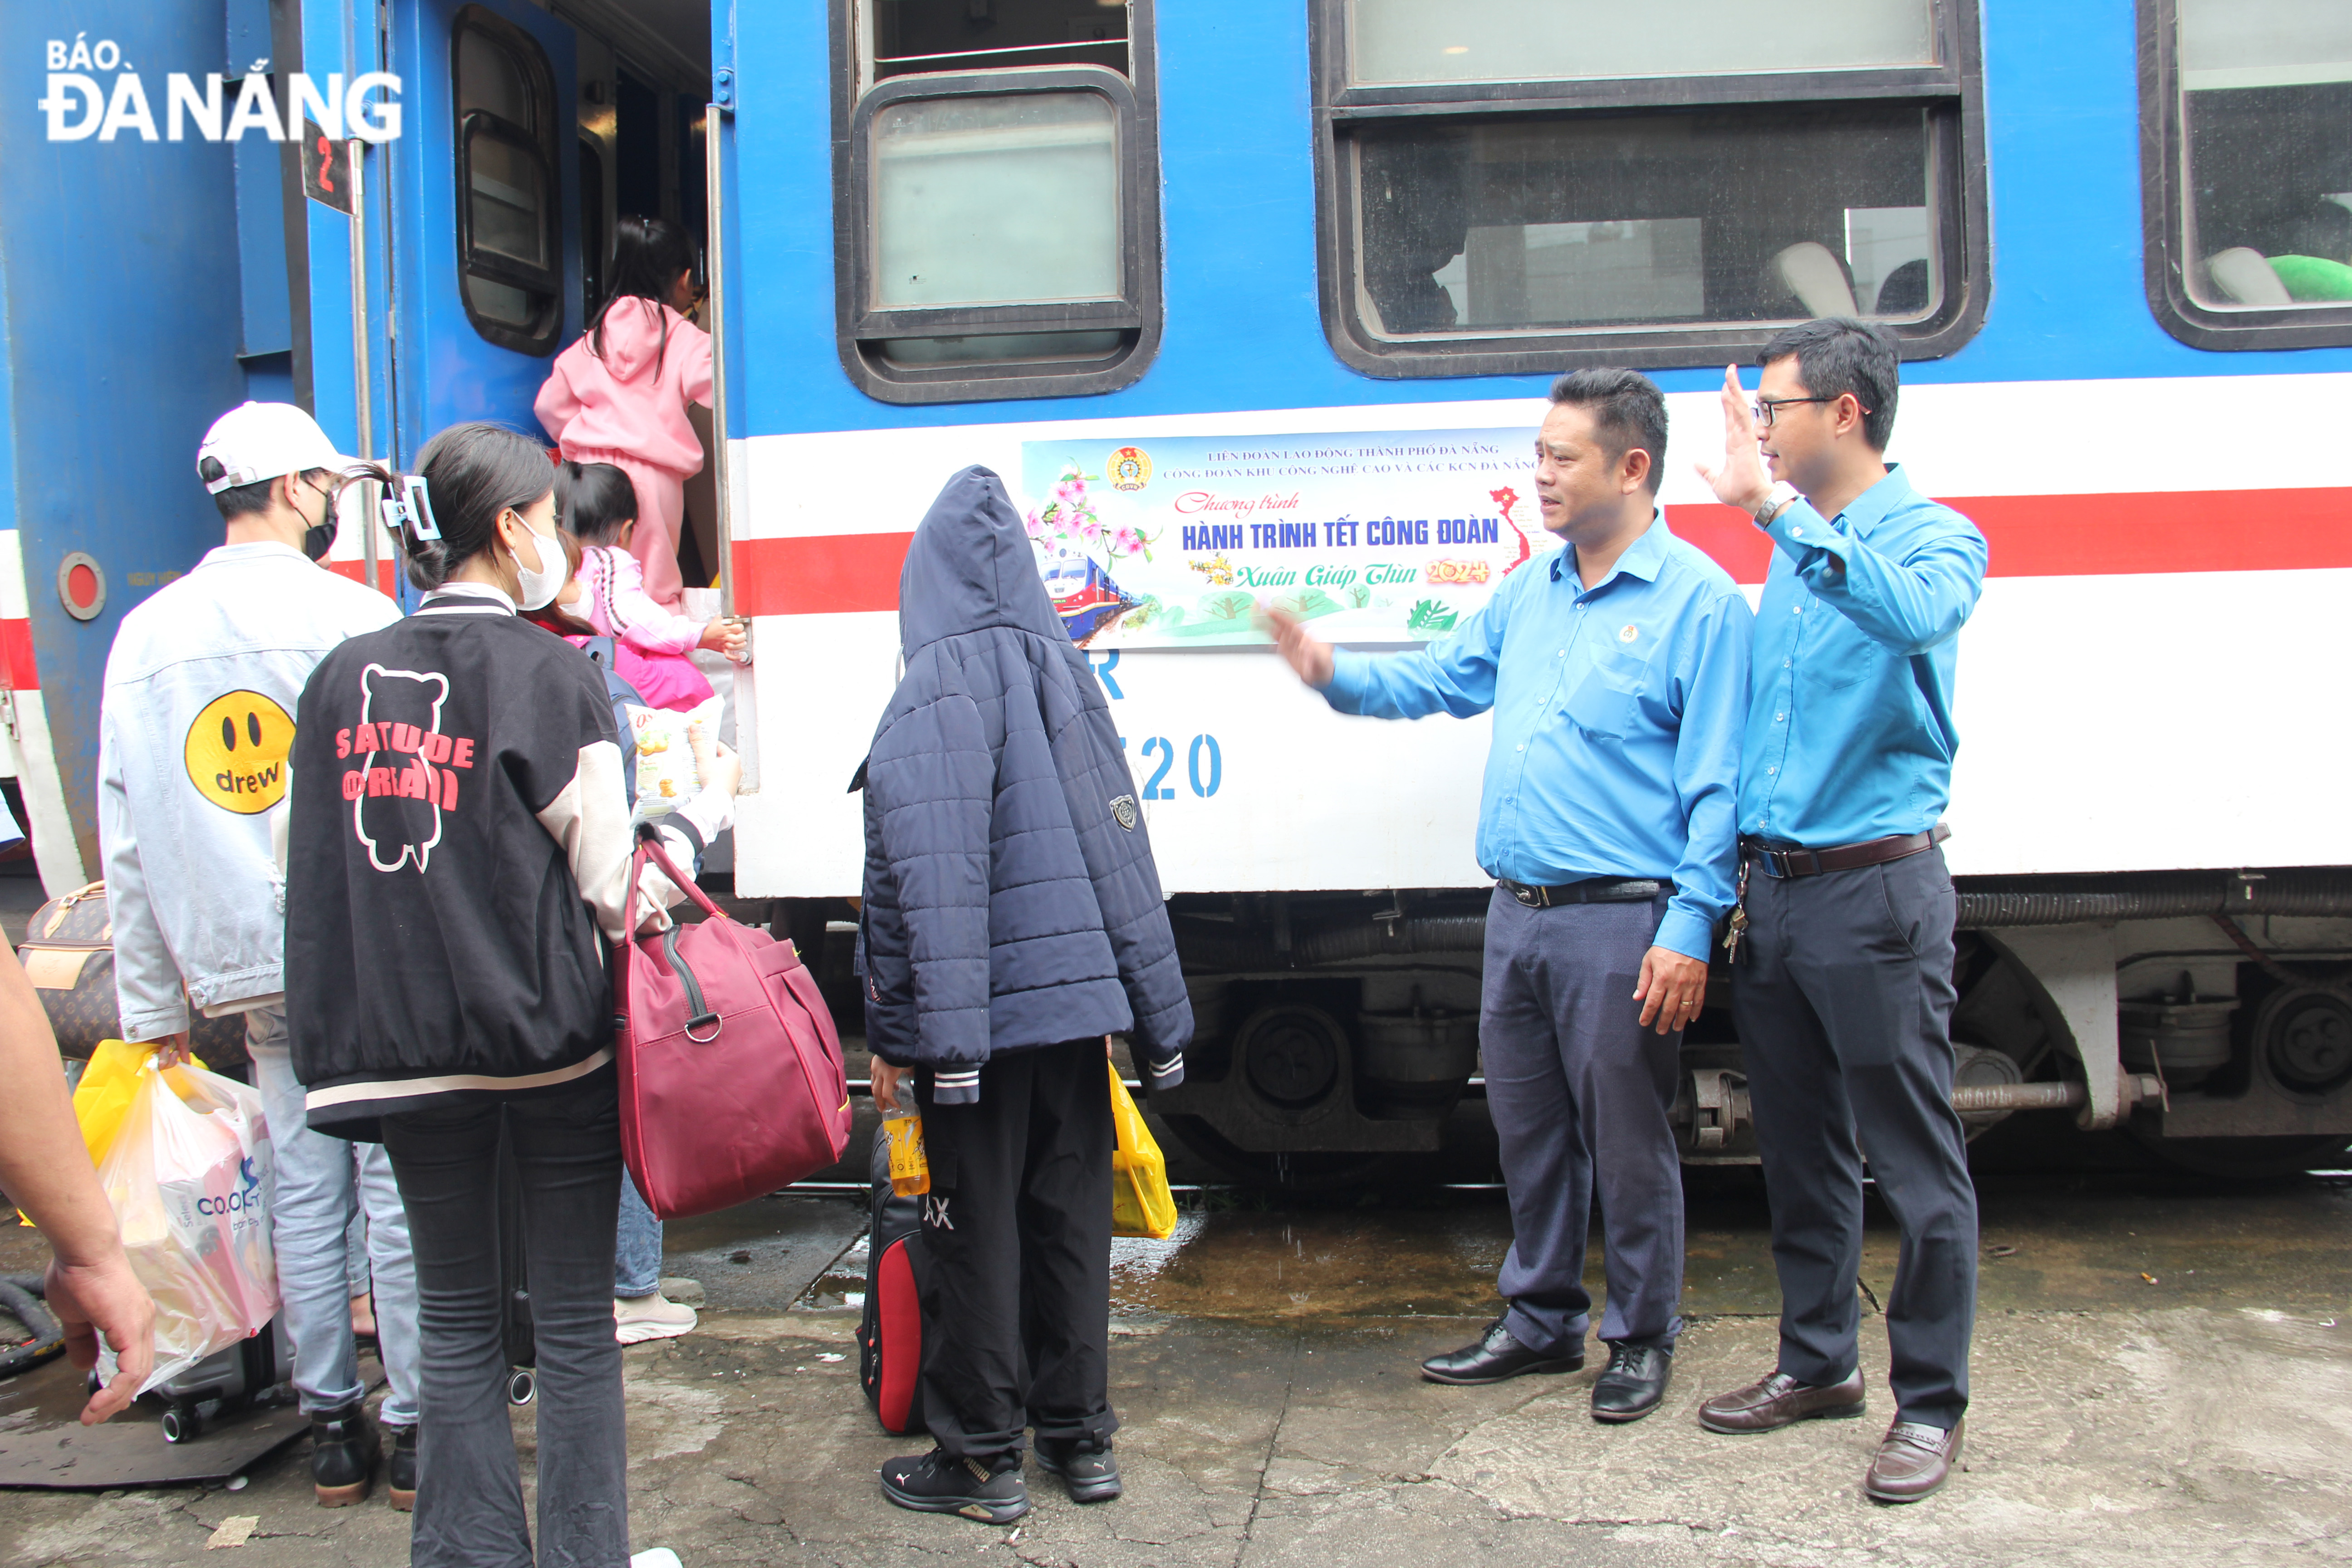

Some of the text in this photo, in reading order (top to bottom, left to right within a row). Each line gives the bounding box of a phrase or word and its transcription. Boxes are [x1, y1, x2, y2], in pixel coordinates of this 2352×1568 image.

[1208, 442, 1499, 461] LIÊN ĐOÀN LAO ĐỘNG THÀNH PHỐ ĐÀ NẴNG
[1163, 468, 1201, 479] CÔNG
[1205, 467, 1242, 478] ĐOÀN
[1246, 467, 1275, 476] KHU
[1279, 465, 1316, 475] CÔNG
[1321, 463, 1358, 476] NGHỆ
[1362, 464, 1391, 473] CAO
[1395, 462, 1412, 472] VÀ
[1417, 461, 1444, 472] CÁC
[1449, 462, 1477, 471] KCN
[1480, 459, 1498, 470] ĐÀ
[1174, 491, 1300, 519] Chương trình
[1182, 514, 1499, 550] HÀNH TRÌNH TẾT CÔNG ĐOÀN
[1234, 563, 1418, 590] Xuân Giáp Thìn
[1425, 559, 1491, 584] 2024
[336, 721, 475, 769] SATUDE
[216, 761, 279, 794] drew
[1119, 734, 1221, 800] 20
[963, 1456, 991, 1483] PUMA
